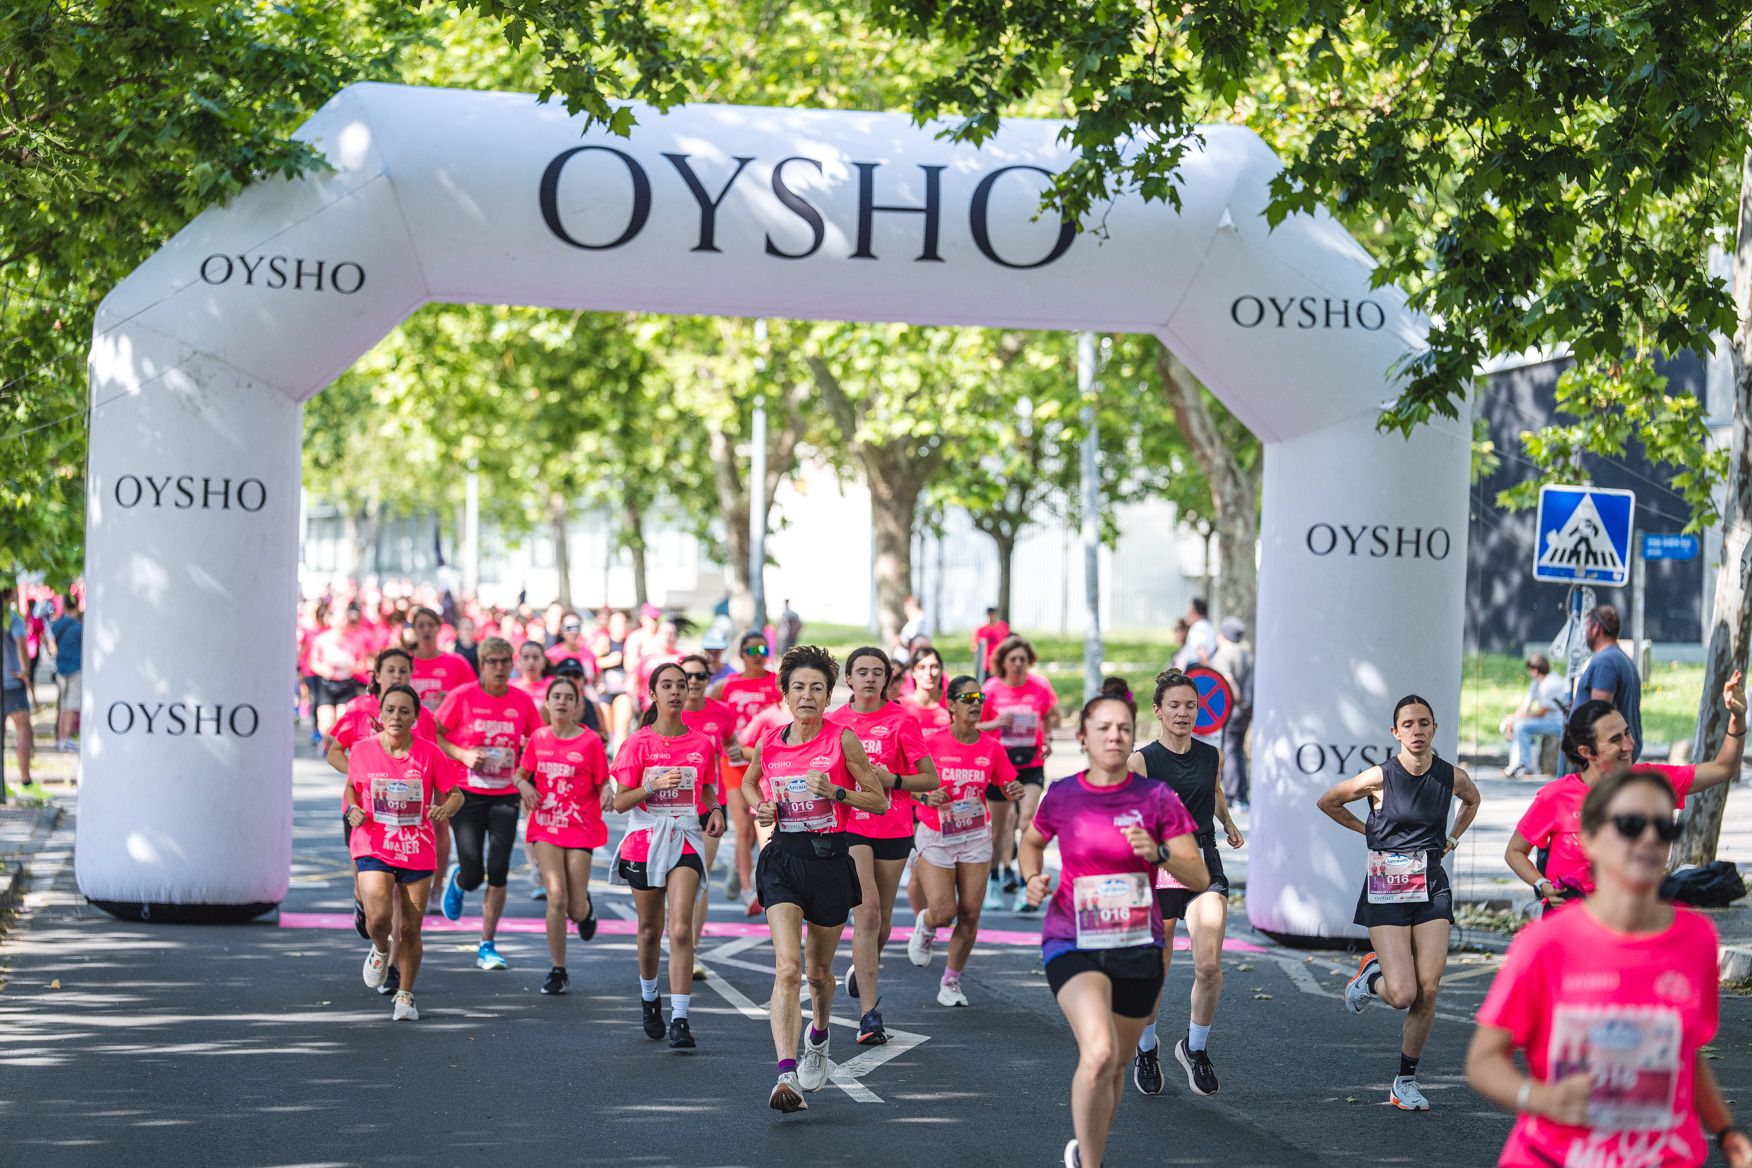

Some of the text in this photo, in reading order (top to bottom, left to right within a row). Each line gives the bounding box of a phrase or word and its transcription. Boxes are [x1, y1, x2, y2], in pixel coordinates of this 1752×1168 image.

[539, 145, 1076, 269] OYSHO
[200, 253, 366, 294] OYSHO
[1230, 294, 1385, 331] OYSHO
[115, 474, 267, 513] OYSHO
[1305, 522, 1451, 561] OYSHO
[107, 700, 259, 738] OYSHO
[768, 760, 791, 769] OYSHO
[1296, 742, 1438, 776] OYS
[941, 767, 985, 783] CARRERA
[387, 800, 407, 810] 016
[660, 789, 679, 799] 016
[791, 801, 814, 812] 016
[1386, 874, 1409, 884] 016
[1100, 908, 1131, 922] 016
